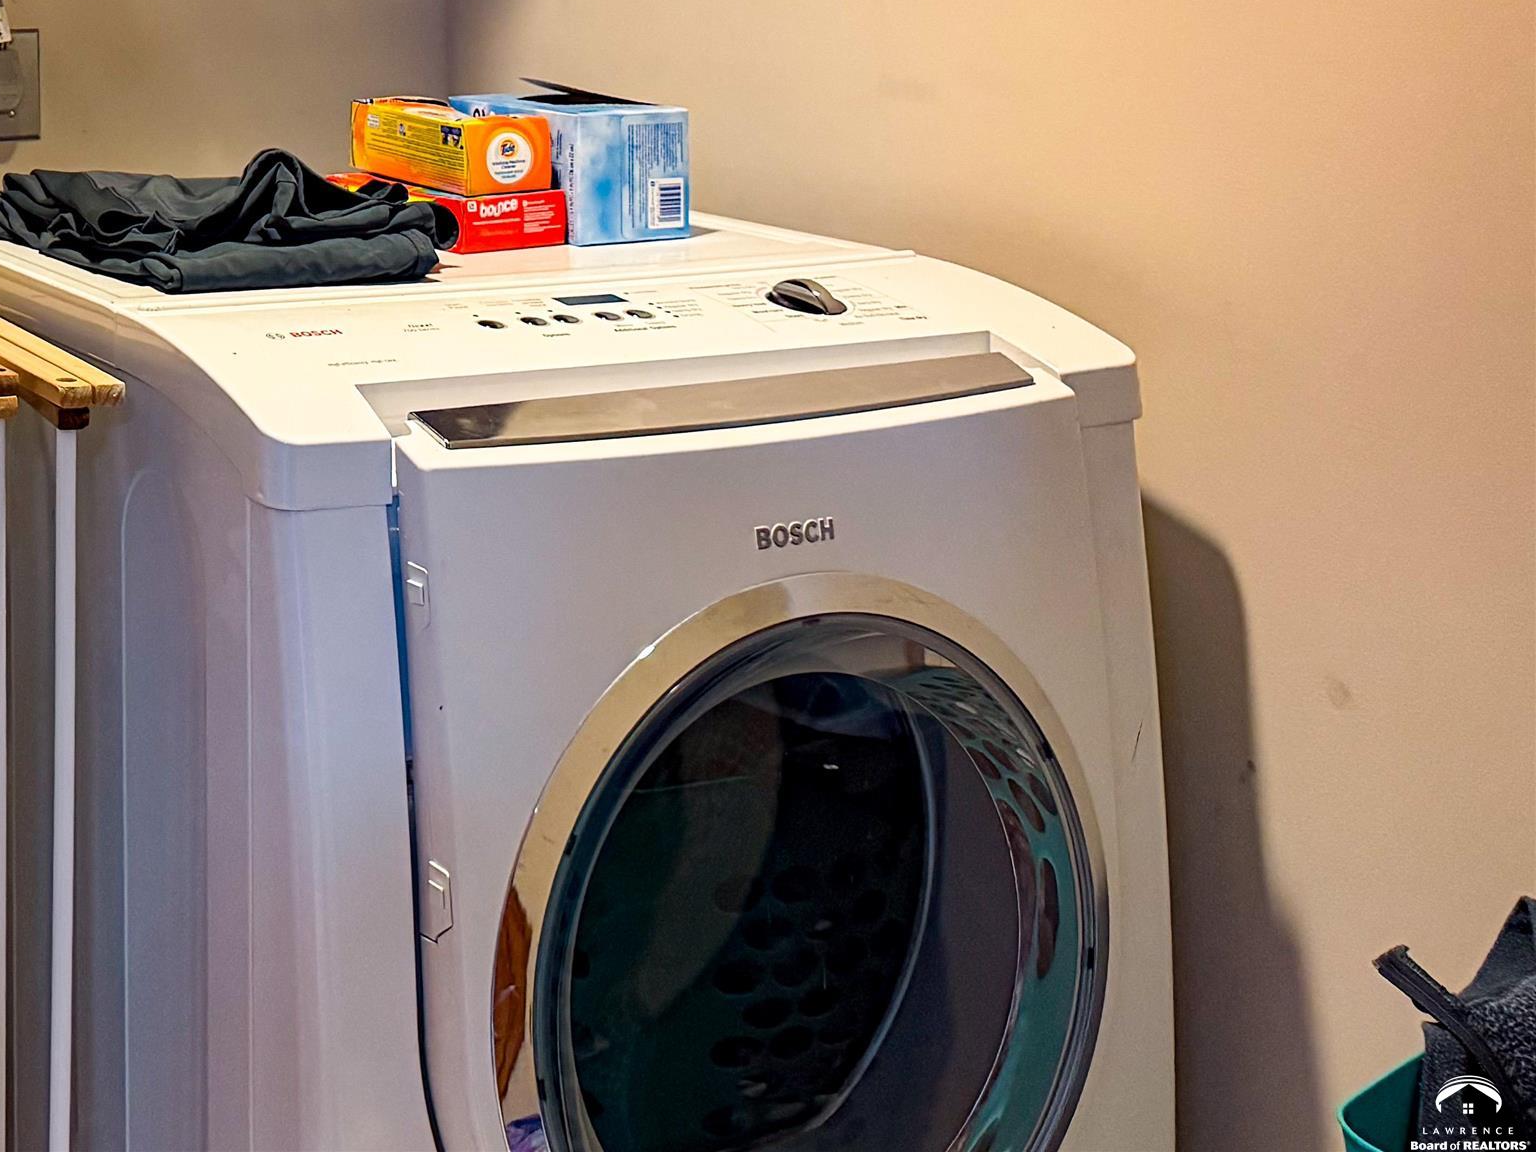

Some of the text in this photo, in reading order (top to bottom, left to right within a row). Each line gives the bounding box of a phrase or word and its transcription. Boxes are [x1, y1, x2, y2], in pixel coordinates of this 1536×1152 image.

[479, 198, 518, 218] bounce
[289, 329, 343, 338] BOSCH
[754, 517, 835, 550] BOSCH
